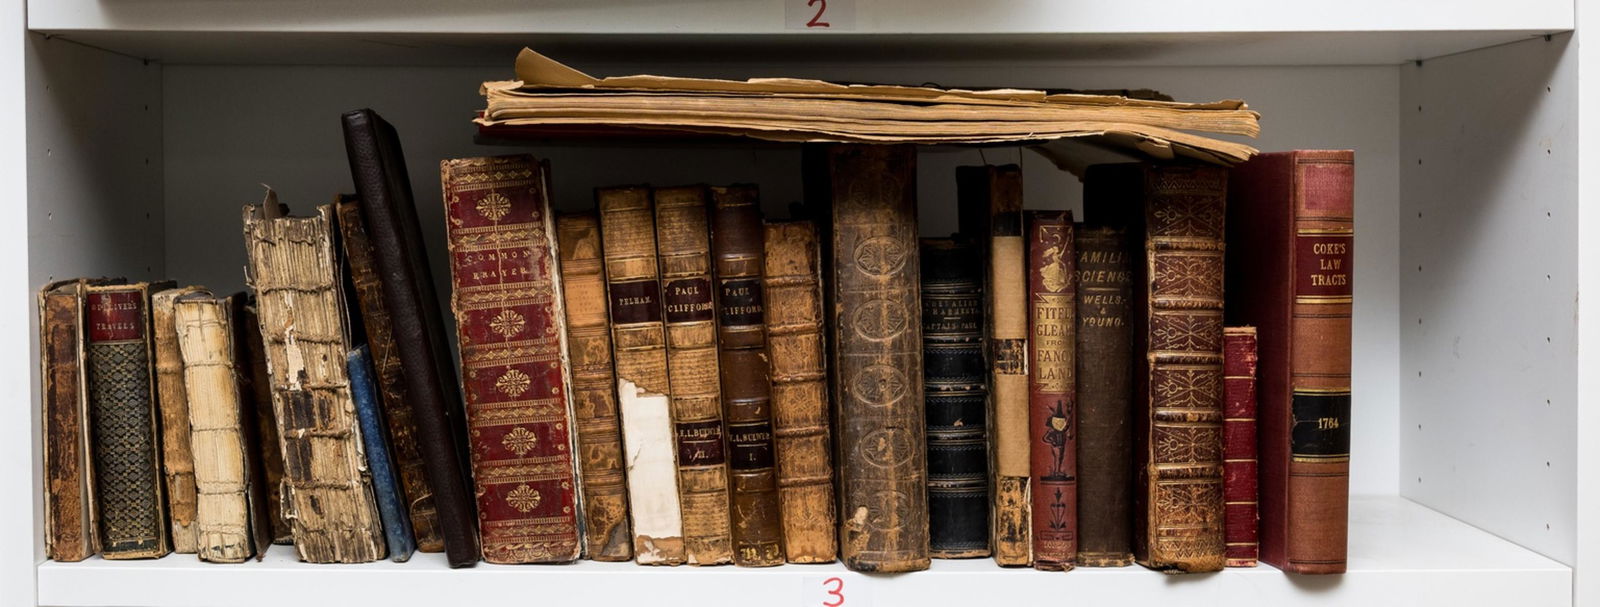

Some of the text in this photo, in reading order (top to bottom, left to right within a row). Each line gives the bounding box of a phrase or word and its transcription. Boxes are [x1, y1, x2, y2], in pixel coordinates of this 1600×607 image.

[806, 0, 830, 27] 2
[1313, 243, 1346, 255] COKE'S
[467, 250, 530, 262] COMMON
[1320, 259, 1341, 270] LAW
[1310, 274, 1346, 286] TRACTS
[675, 287, 699, 296] PAUL
[725, 287, 750, 297] PAUL
[96, 322, 135, 330] TRAVELS
[1039, 368, 1073, 380] LAND
[1318, 417, 1339, 429] 1764
[822, 577, 844, 607] 3
